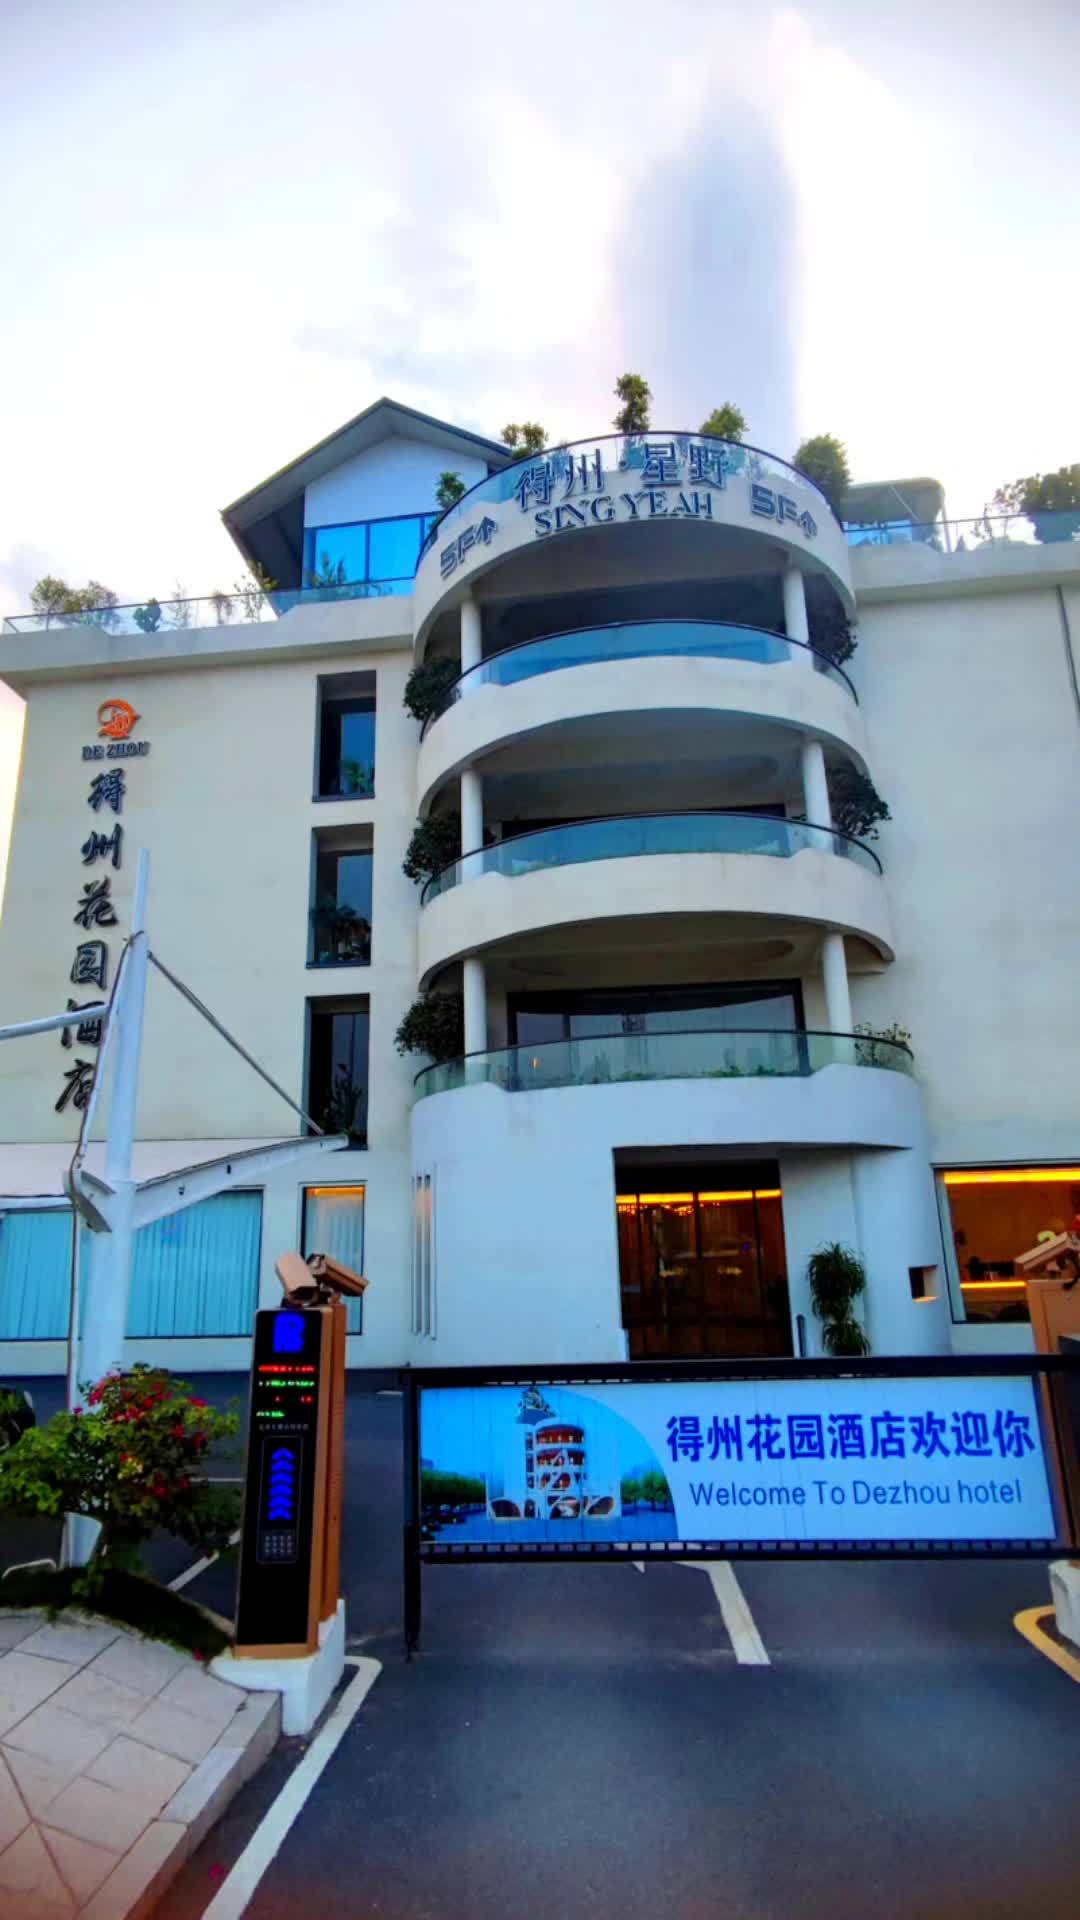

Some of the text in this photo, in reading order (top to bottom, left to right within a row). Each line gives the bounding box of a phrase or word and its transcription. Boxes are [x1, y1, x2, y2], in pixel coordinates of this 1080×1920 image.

[106, 741, 150, 759] ZHOU
[666, 1411, 1035, 1462] 得州花园酒店欢迎你
[689, 1479, 1022, 1507] Welcome To Dezhou hotel
